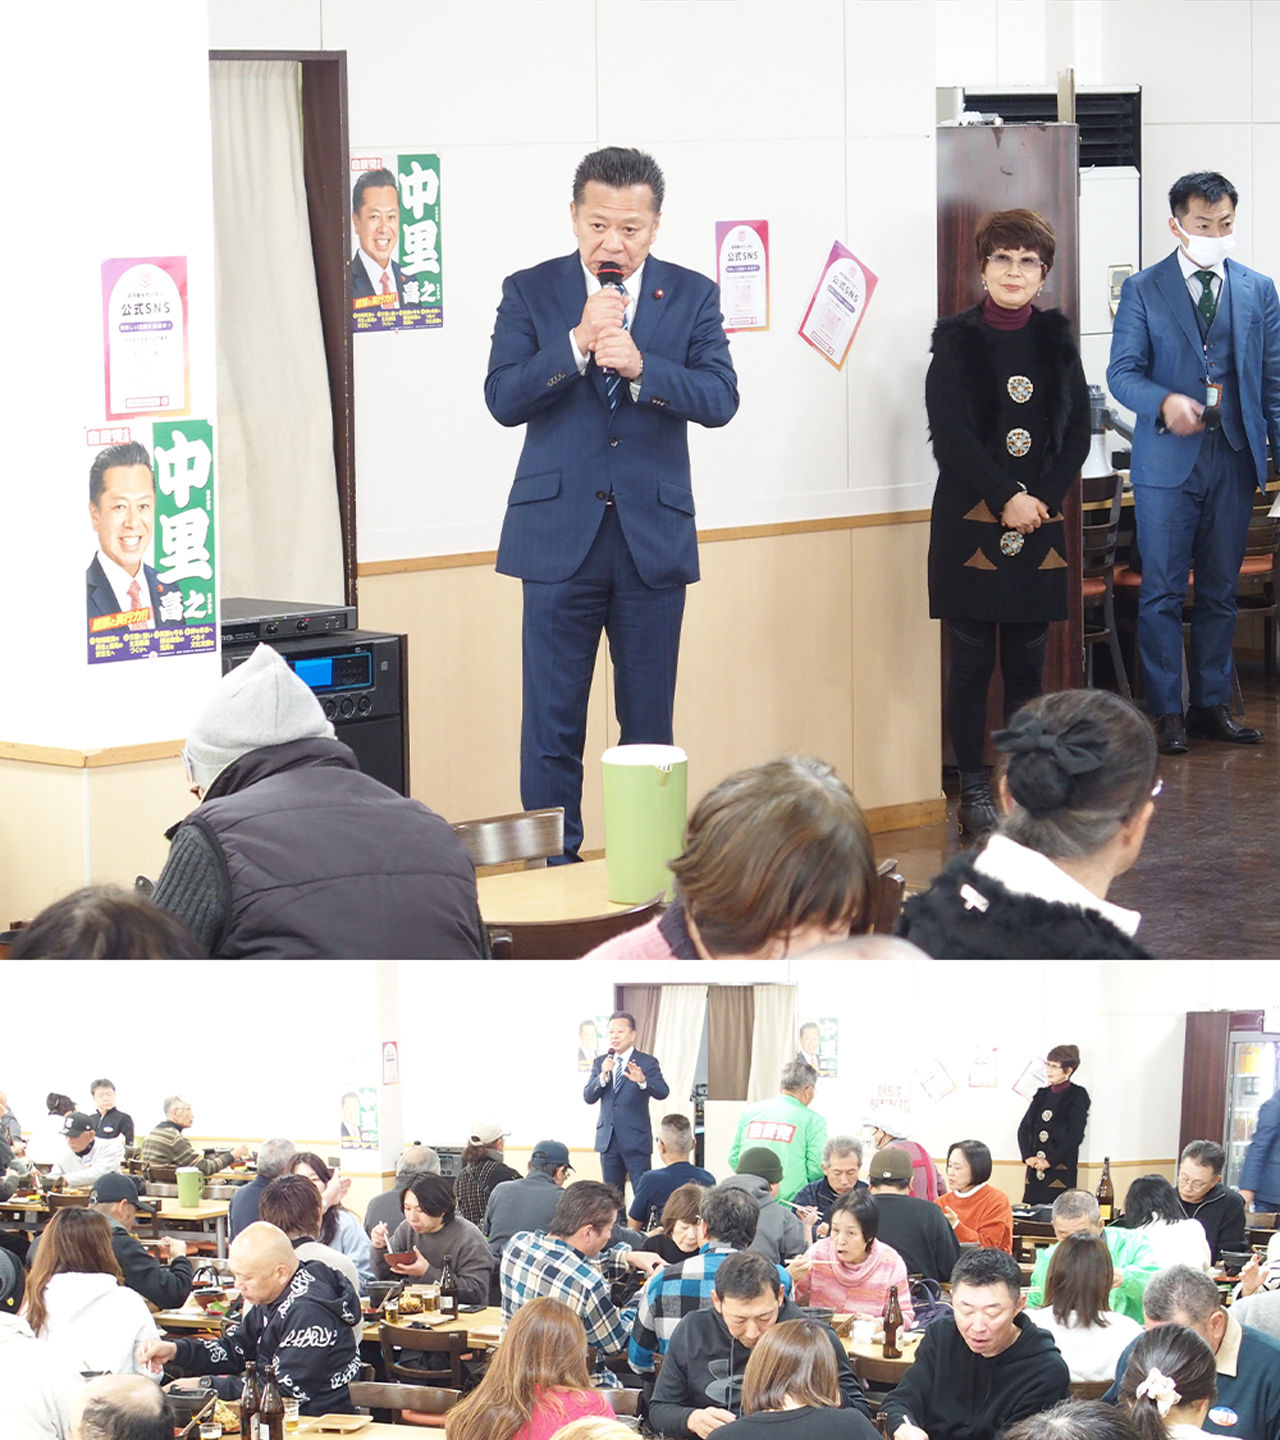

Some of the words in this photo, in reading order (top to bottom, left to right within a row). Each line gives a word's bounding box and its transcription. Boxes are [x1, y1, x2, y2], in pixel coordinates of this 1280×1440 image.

[399, 160, 440, 276] 中里
[727, 251, 758, 262] 公式SNS
[121, 301, 171, 317] 公式SNS
[154, 429, 213, 584] 中里
[748, 1122, 793, 1142] 自民党
